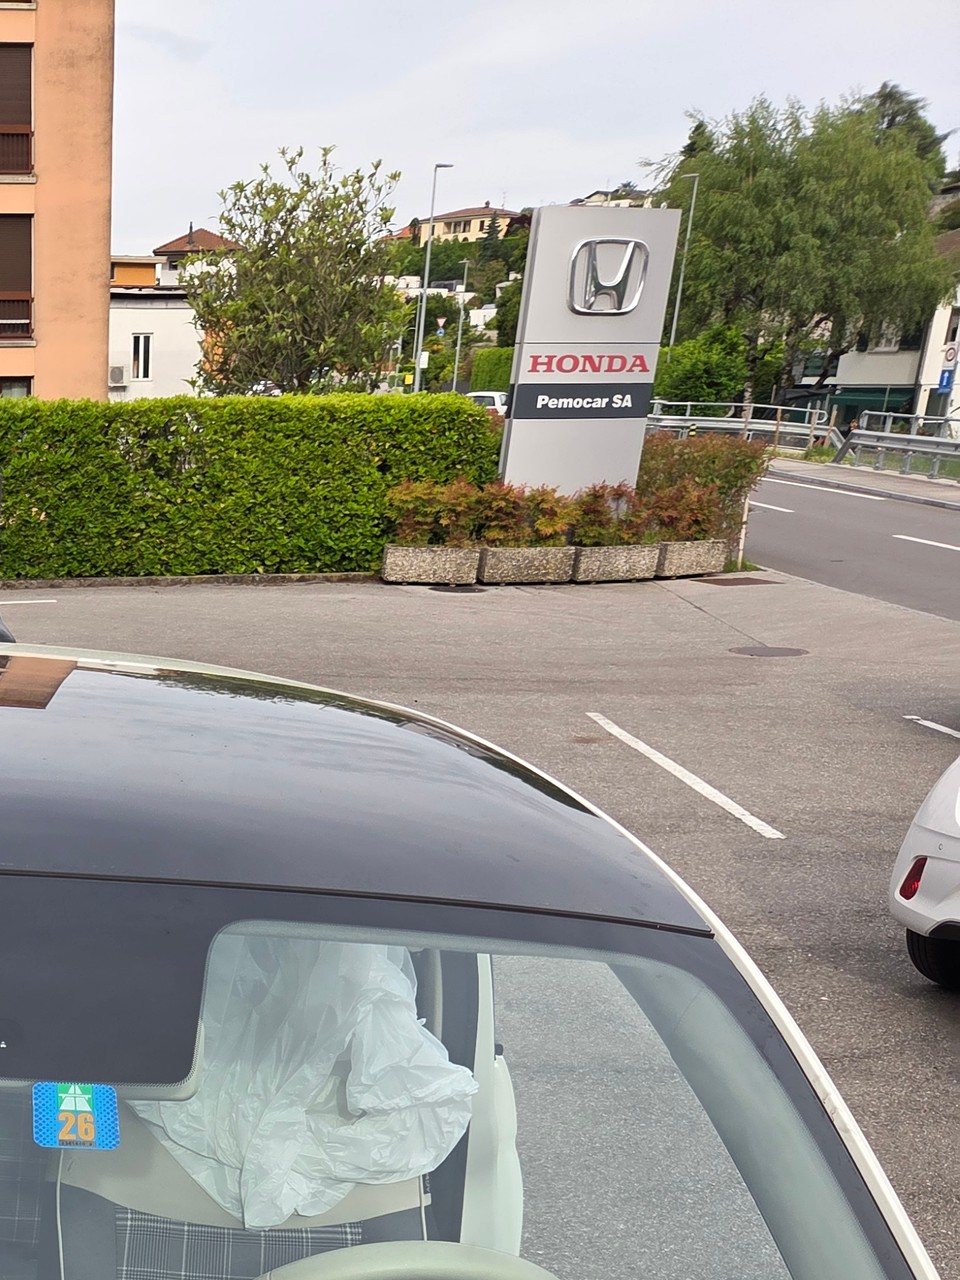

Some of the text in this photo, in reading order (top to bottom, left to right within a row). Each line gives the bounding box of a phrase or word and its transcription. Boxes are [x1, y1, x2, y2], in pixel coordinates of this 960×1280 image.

[528, 355, 650, 373] HONDA
[536, 394, 633, 409] Pemocar SA
[58, 1111, 95, 1141] 26
